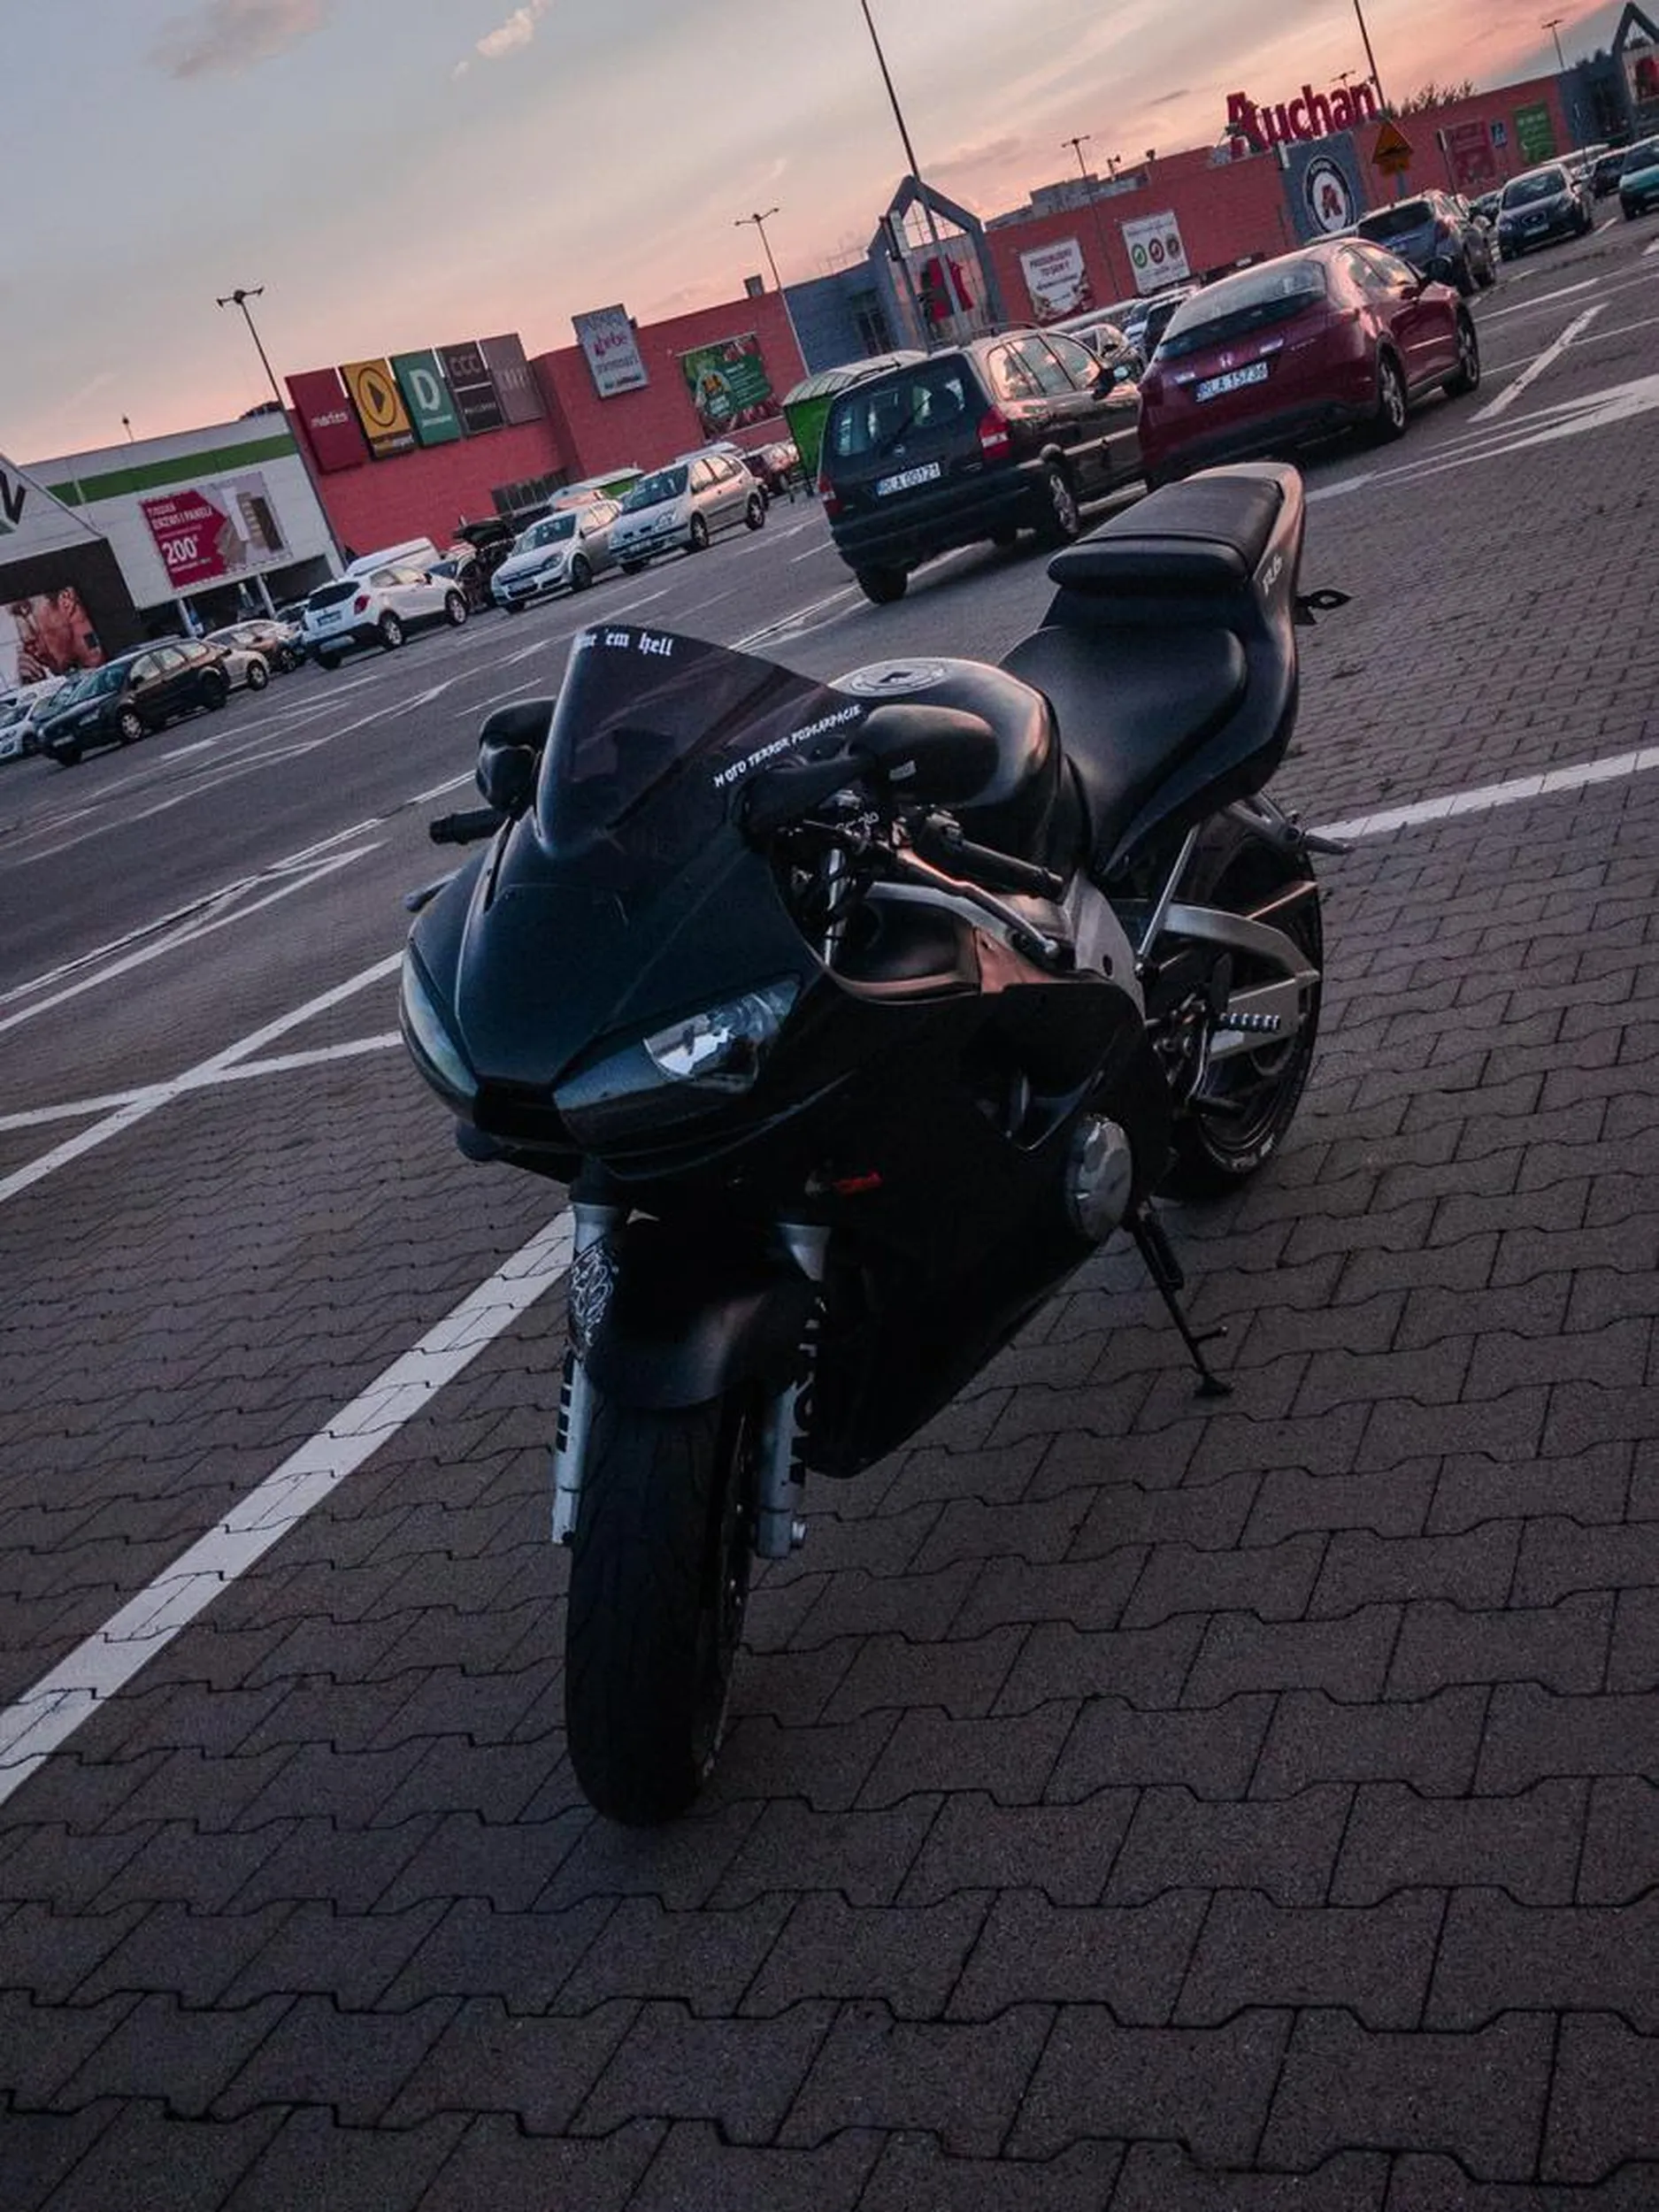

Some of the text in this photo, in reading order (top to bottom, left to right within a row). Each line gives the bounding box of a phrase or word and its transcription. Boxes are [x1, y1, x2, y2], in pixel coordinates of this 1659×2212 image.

[1226, 82, 1377, 159] Auchan
[449, 355, 482, 376] CCC
[639, 632, 673, 657] hell
[748, 735, 791, 768] TERROR
